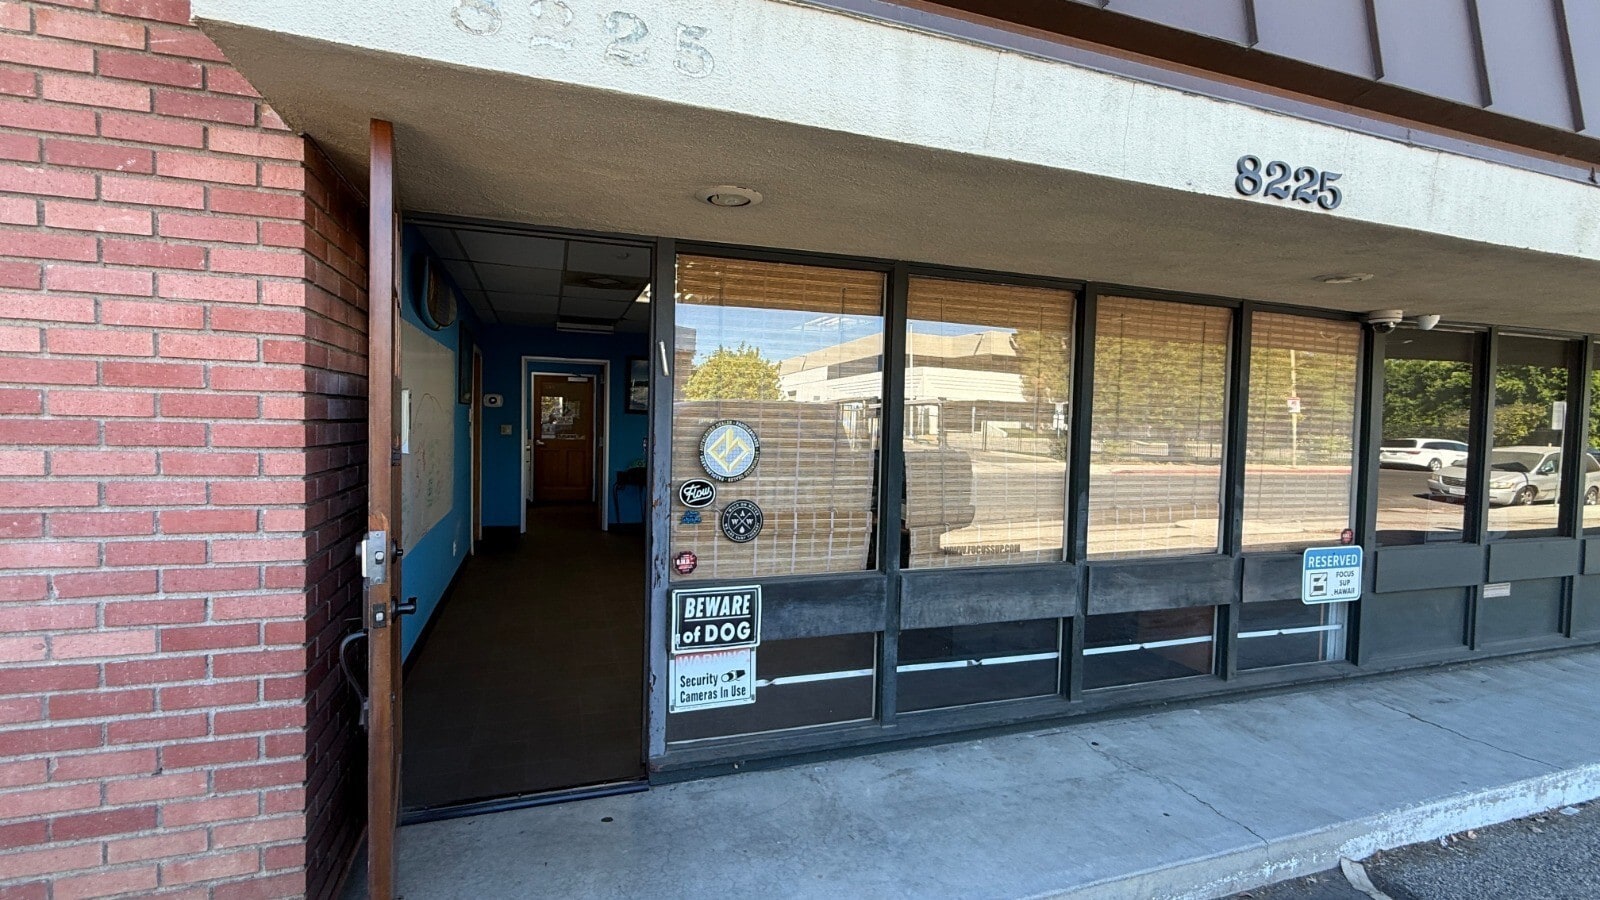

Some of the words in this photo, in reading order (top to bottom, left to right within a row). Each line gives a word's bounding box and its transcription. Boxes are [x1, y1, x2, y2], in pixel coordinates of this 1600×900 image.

[1235, 154, 1342, 210] 8225
[683, 484, 713, 503] Flow
[1308, 554, 1358, 568] RESERVED
[684, 594, 751, 618] BEWARE
[682, 626, 701, 643] of
[705, 621, 751, 642] DOG
[680, 673, 718, 687] Security
[680, 690, 717, 703] Cameras
[720, 686, 729, 698] In
[731, 684, 746, 697] Use
